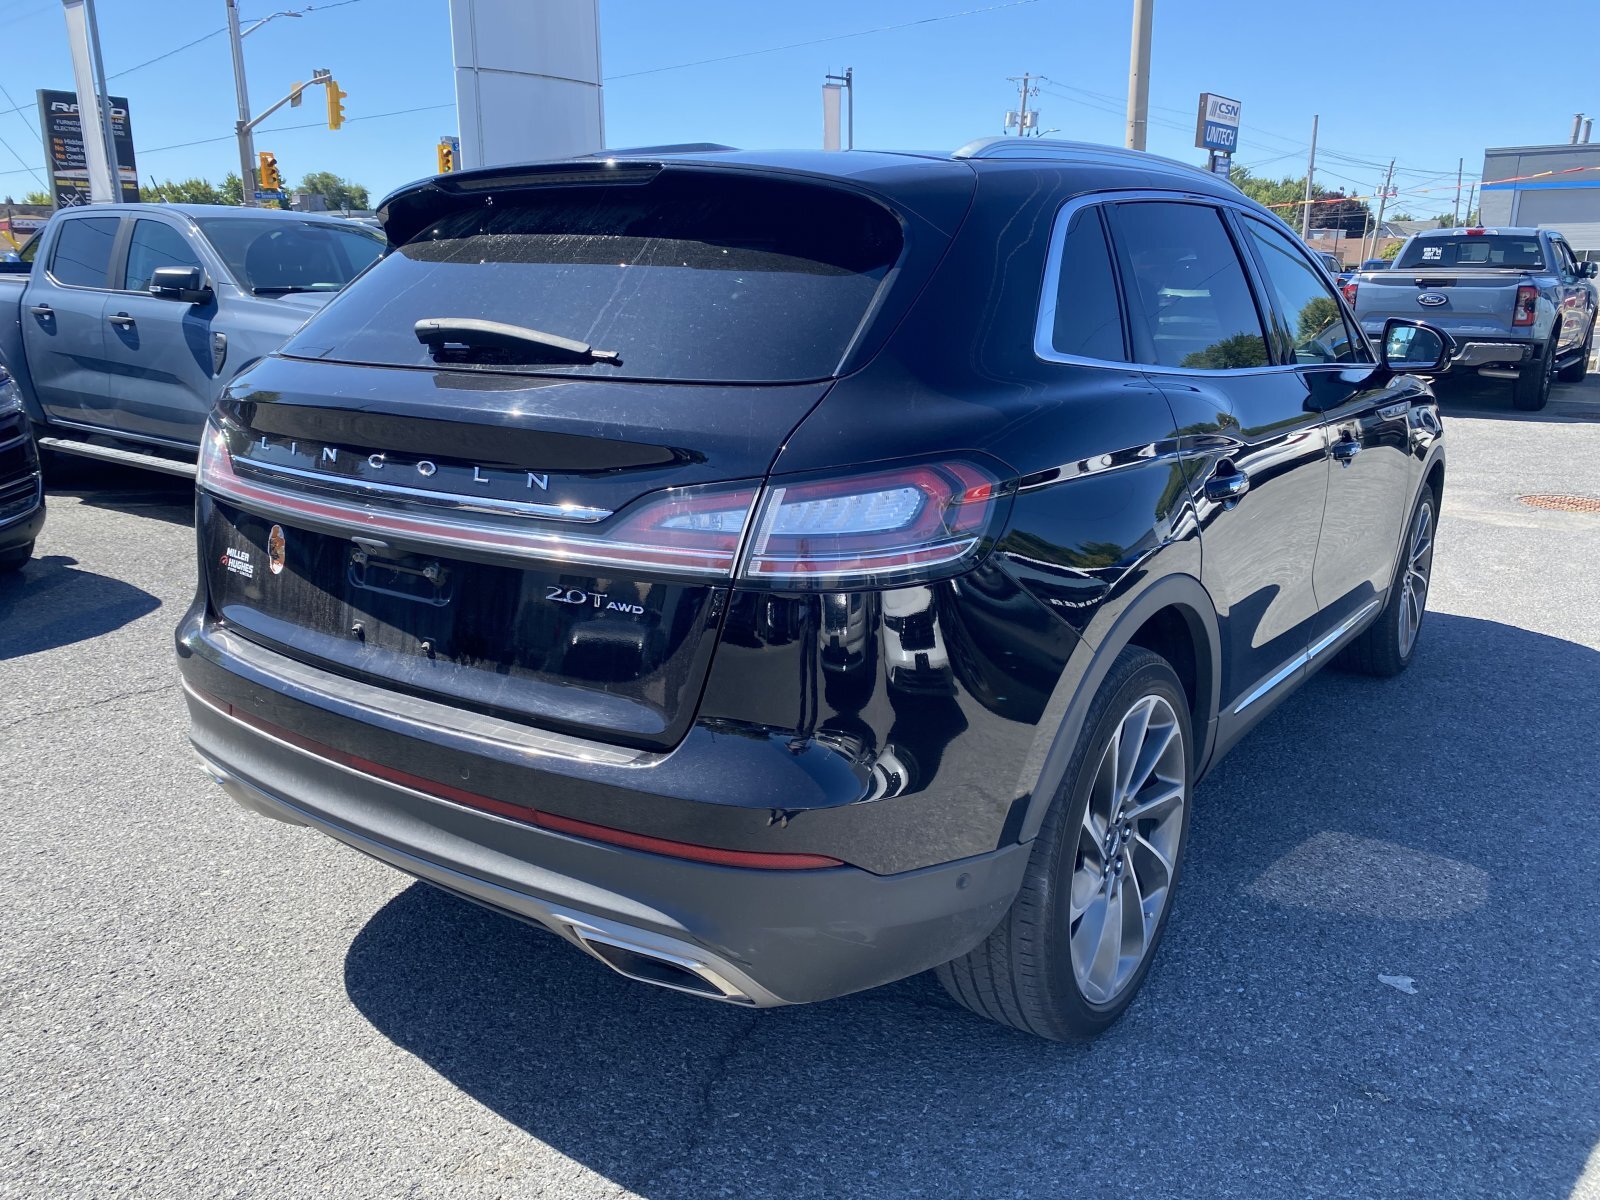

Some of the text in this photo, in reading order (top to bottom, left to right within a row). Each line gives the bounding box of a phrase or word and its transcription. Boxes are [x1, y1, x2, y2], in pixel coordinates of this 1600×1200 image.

[1218, 103, 1239, 116] CSN
[1206, 126, 1235, 146] UNITECH
[260, 436, 549, 490] LINCOLN
[226, 547, 250, 562] MILLER
[227, 558, 254, 574] HUGHES
[606, 601, 645, 615] AWD
